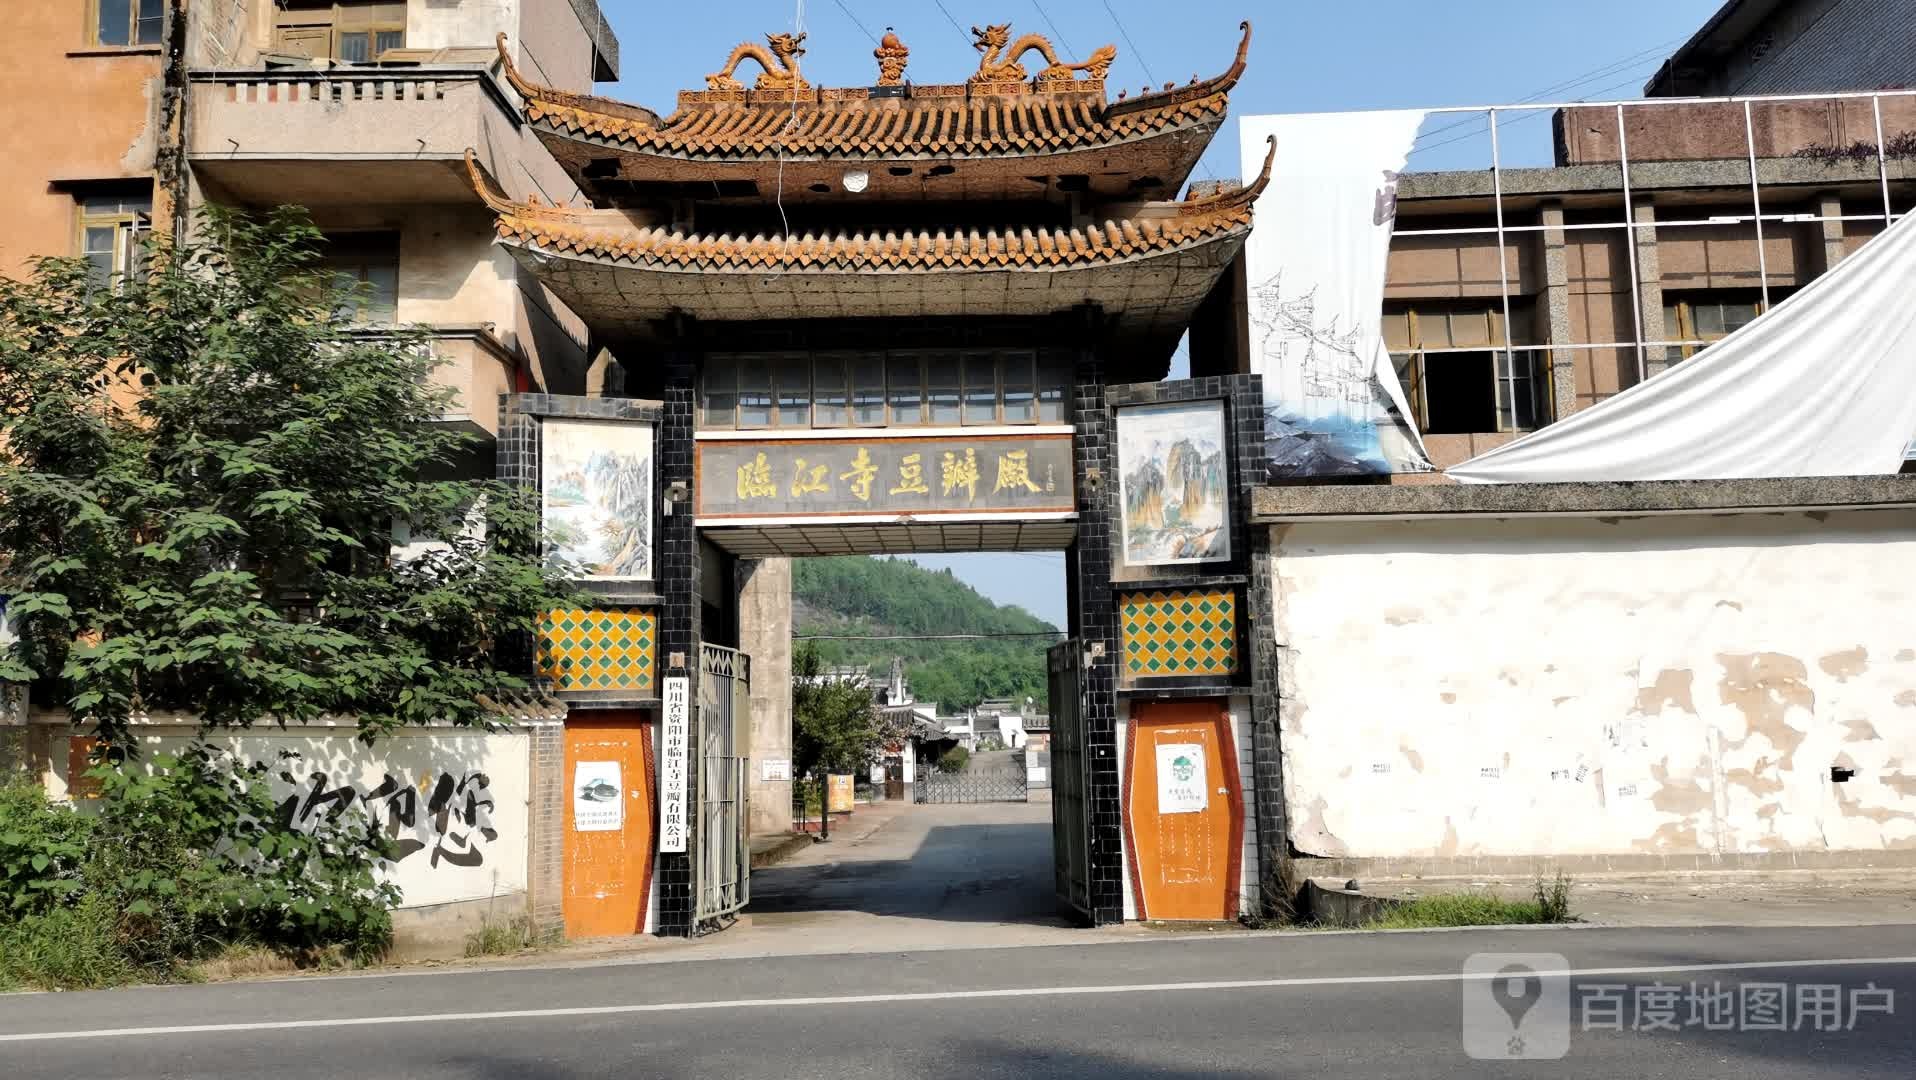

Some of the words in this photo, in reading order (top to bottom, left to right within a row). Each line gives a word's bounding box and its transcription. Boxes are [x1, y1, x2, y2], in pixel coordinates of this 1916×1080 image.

[666, 681, 682, 847] 四川省资阳市临江寺豆瓣有限公司
